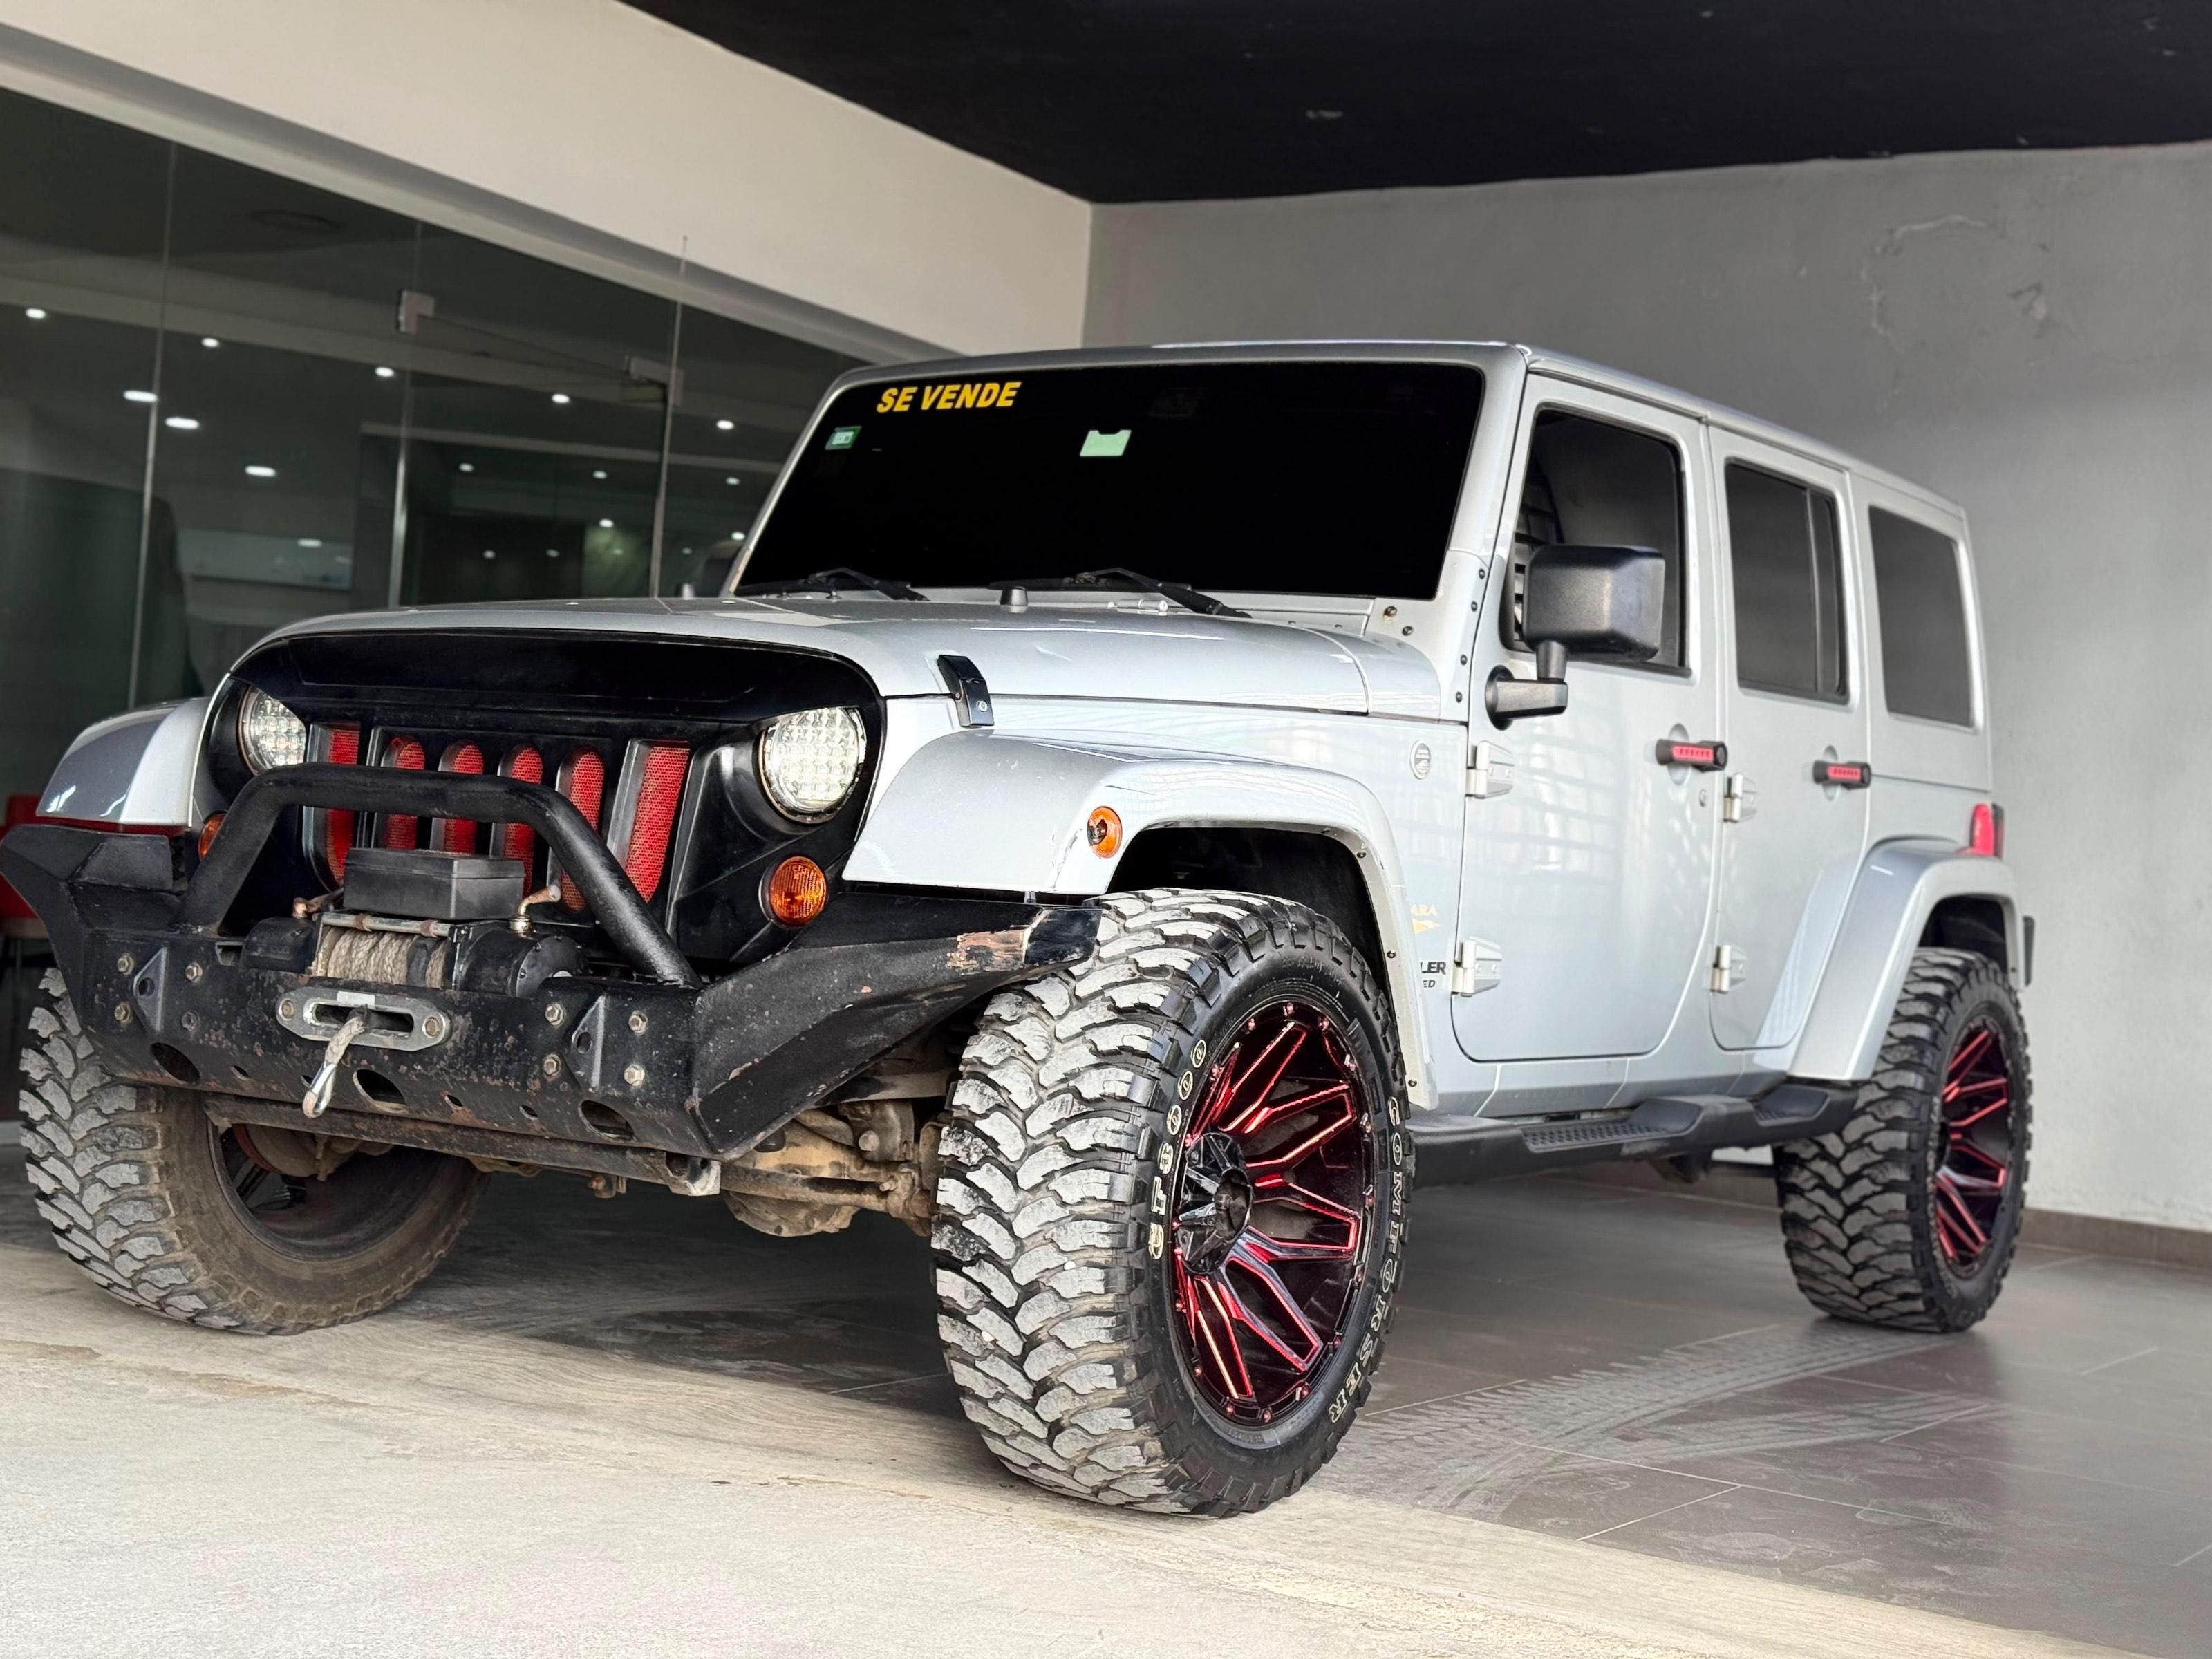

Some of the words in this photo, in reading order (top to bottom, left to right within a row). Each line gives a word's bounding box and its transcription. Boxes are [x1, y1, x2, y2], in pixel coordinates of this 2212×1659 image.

[877, 386, 918, 413] SE
[921, 382, 1022, 410] VENDE
[1329, 1096, 1403, 1423] COMFORSER
